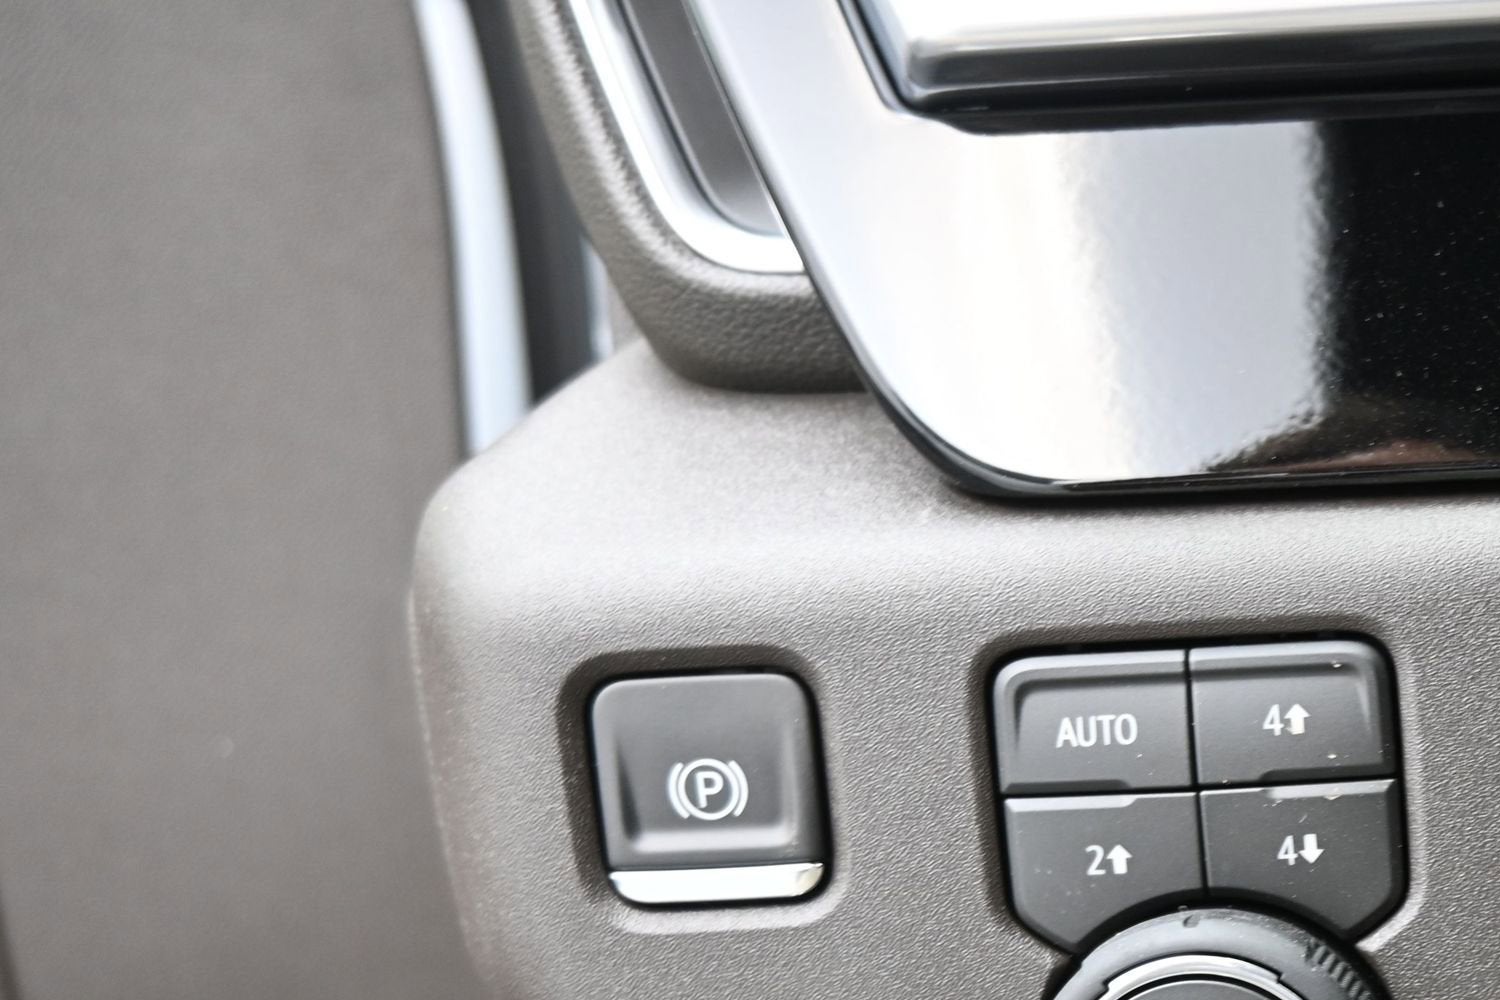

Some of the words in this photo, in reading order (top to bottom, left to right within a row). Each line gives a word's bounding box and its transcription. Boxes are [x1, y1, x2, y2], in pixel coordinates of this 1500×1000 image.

[1055, 714, 1138, 748] AUTO
[1262, 704, 1284, 736] 4
[695, 770, 724, 809] P
[1085, 845, 1106, 876] 2
[1277, 835, 1297, 865] 4
